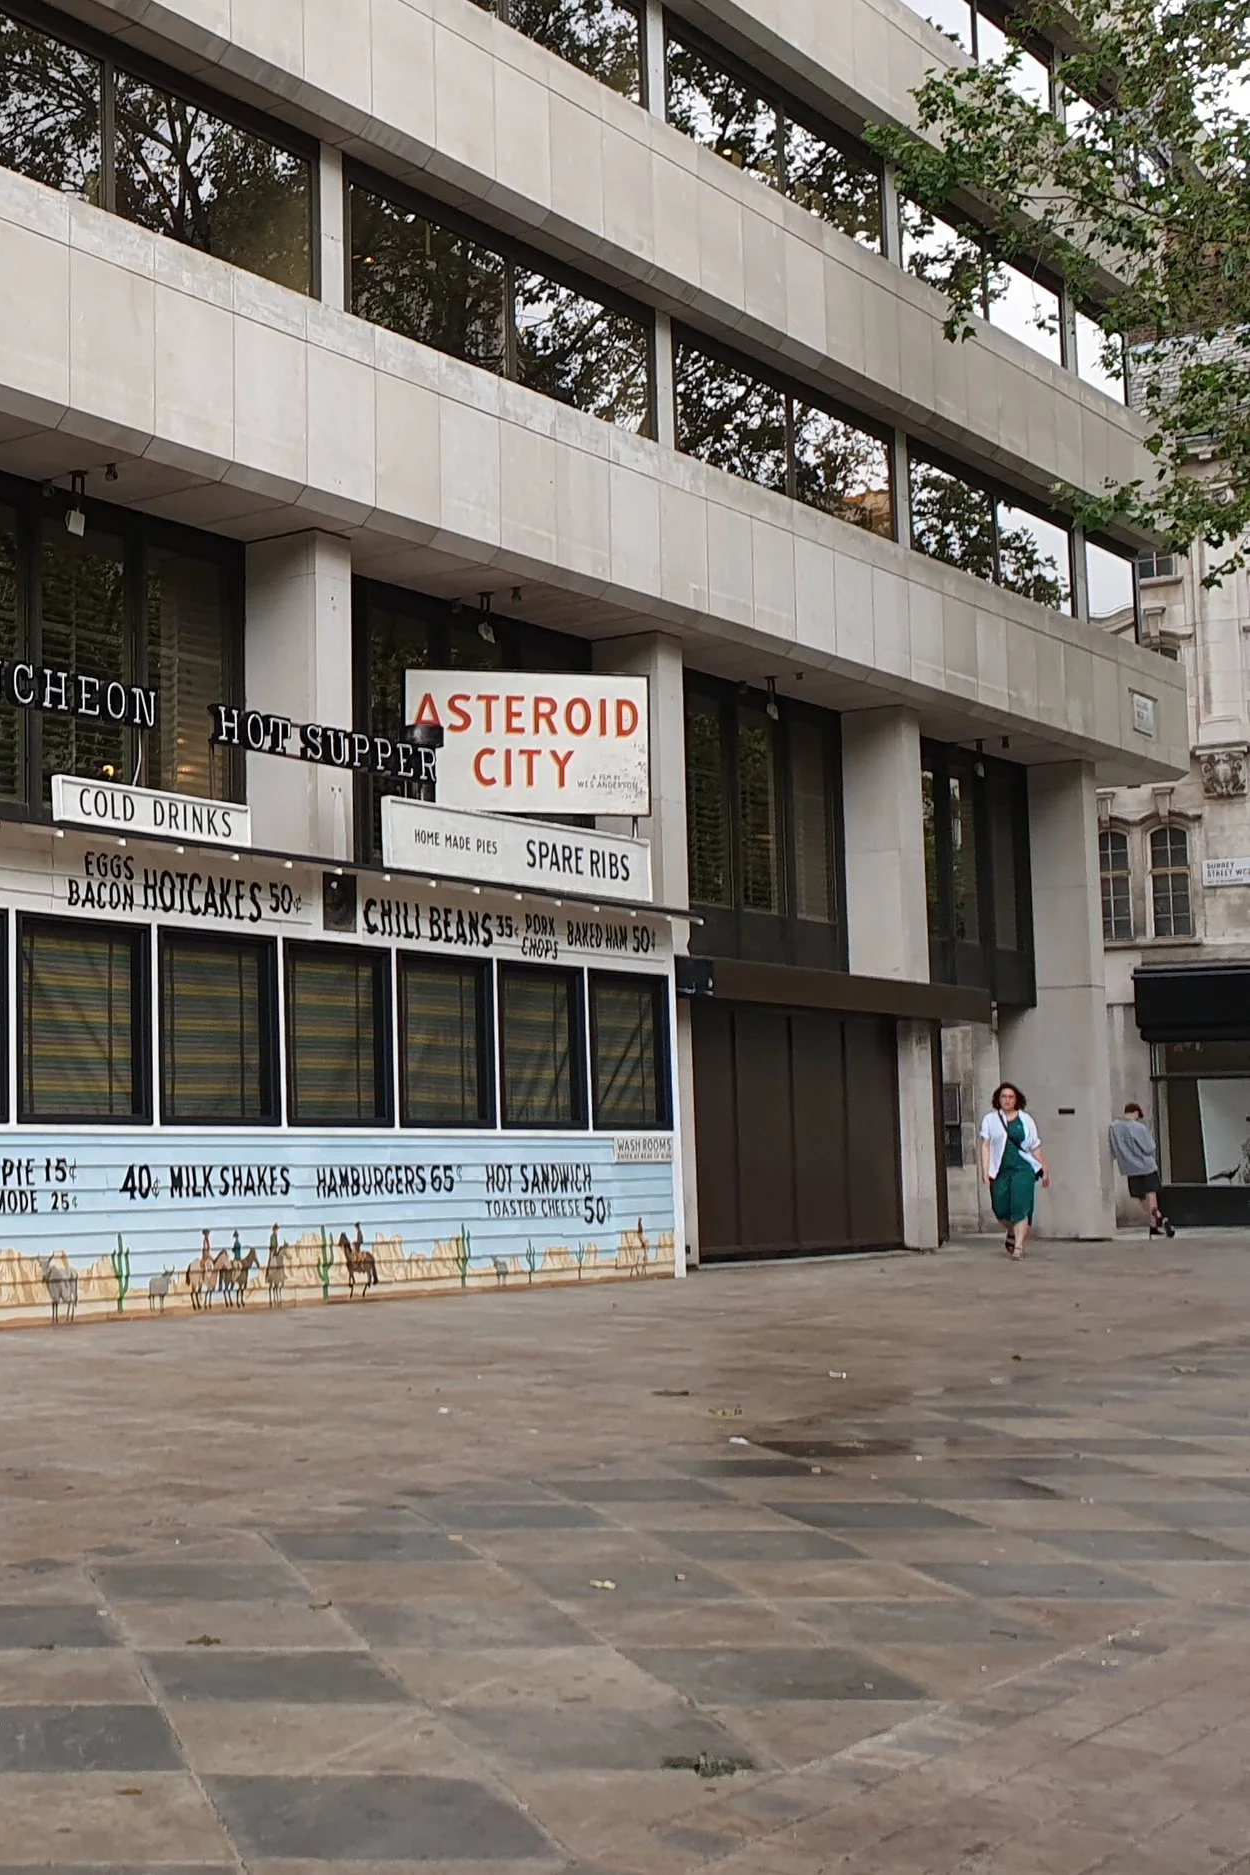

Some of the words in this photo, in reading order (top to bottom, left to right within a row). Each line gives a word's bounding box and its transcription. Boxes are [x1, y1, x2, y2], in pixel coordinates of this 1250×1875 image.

[414, 693, 639, 737] ASTEROID
[213, 704, 292, 753] HOT
[300, 727, 438, 783] SUPPER
[472, 747, 575, 788] CITY
[577, 780, 594, 788] WES
[79, 788, 135, 823] COLD
[152, 807, 233, 838] DRINKS
[414, 829, 440, 846] HOME
[444, 834, 471, 851] MADE
[476, 838, 498, 855] PIES
[83, 850, 135, 882] EGGS
[526, 840, 584, 876] SPARE
[589, 850, 630, 882] RIBS
[66, 877, 135, 914] BACON
[142, 867, 262, 923] HOTCAKES
[362, 897, 422, 941] CHILI
[428, 906, 494, 948] BEANS
[524, 912, 556, 938] PORK
[566, 919, 602, 949] BAKED
[605, 924, 628, 952] HAM
[521, 936, 559, 961] CHOPS
[617, 1139, 641, 1151] WASH
[642, 1138, 671, 1151] ROOMS
[1, 1157, 36, 1187] PIE
[316, 1165, 427, 1199] HAMBURGERS
[485, 1163, 513, 1194] HOT
[520, 1163, 592, 1194] SANDWICH
[485, 1199, 537, 1217] TOASTED
[541, 1198, 582, 1217] CHEESE
